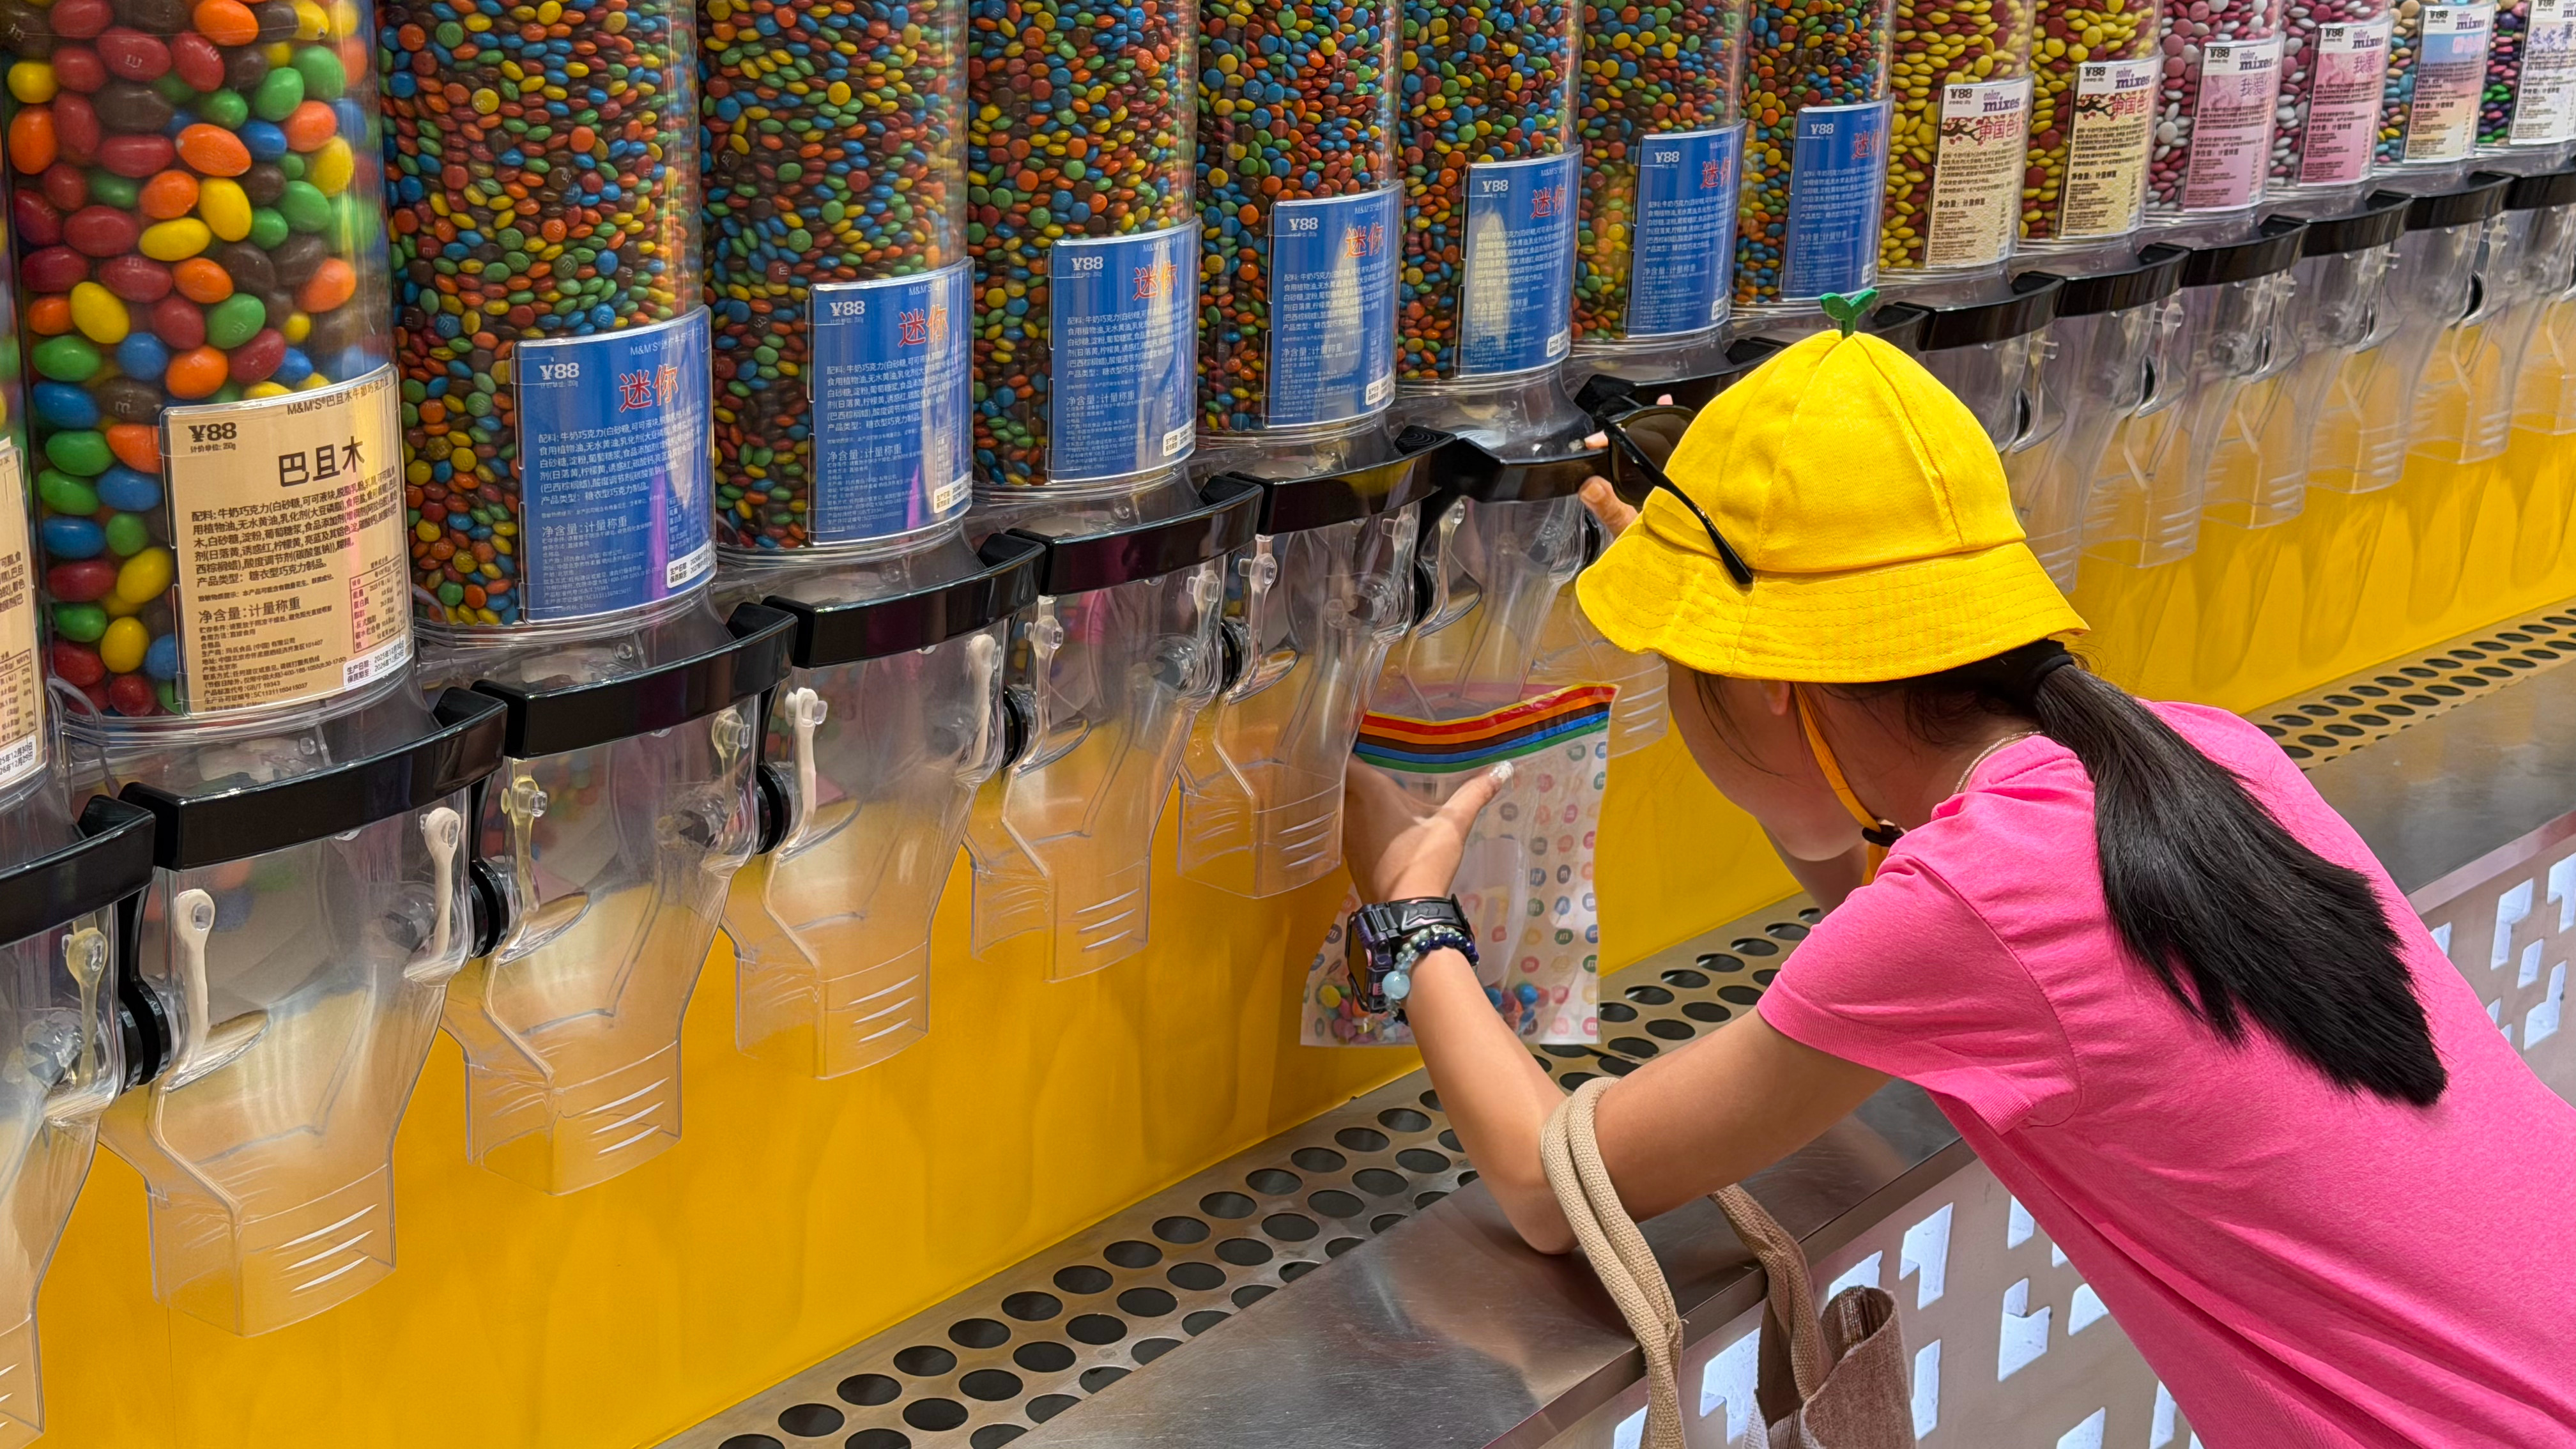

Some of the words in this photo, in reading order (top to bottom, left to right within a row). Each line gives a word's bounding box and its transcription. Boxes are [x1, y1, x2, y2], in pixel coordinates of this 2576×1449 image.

[2115, 73, 2151, 89] mixes
[1983, 89, 2000, 100] color
[1982, 96, 2020, 112] mixes
[1655, 151, 1680, 163] ¥88
[1482, 180, 1509, 192] ¥88
[1289, 217, 1319, 231] ¥88
[1071, 256, 1103, 271] ¥88
[1132, 260, 1178, 301] 迷你
[830, 300, 866, 317] ¥88
[898, 303, 949, 348] 迷你
[539, 362, 579, 380] ¥88
[618, 362, 678, 413] 迷你
[188, 422, 237, 443] ¥88
[279, 436, 365, 487] 巴旦木
[542, 516, 628, 538] 净含量:计量称重
[199, 595, 301, 624] 净含量:计量称重
